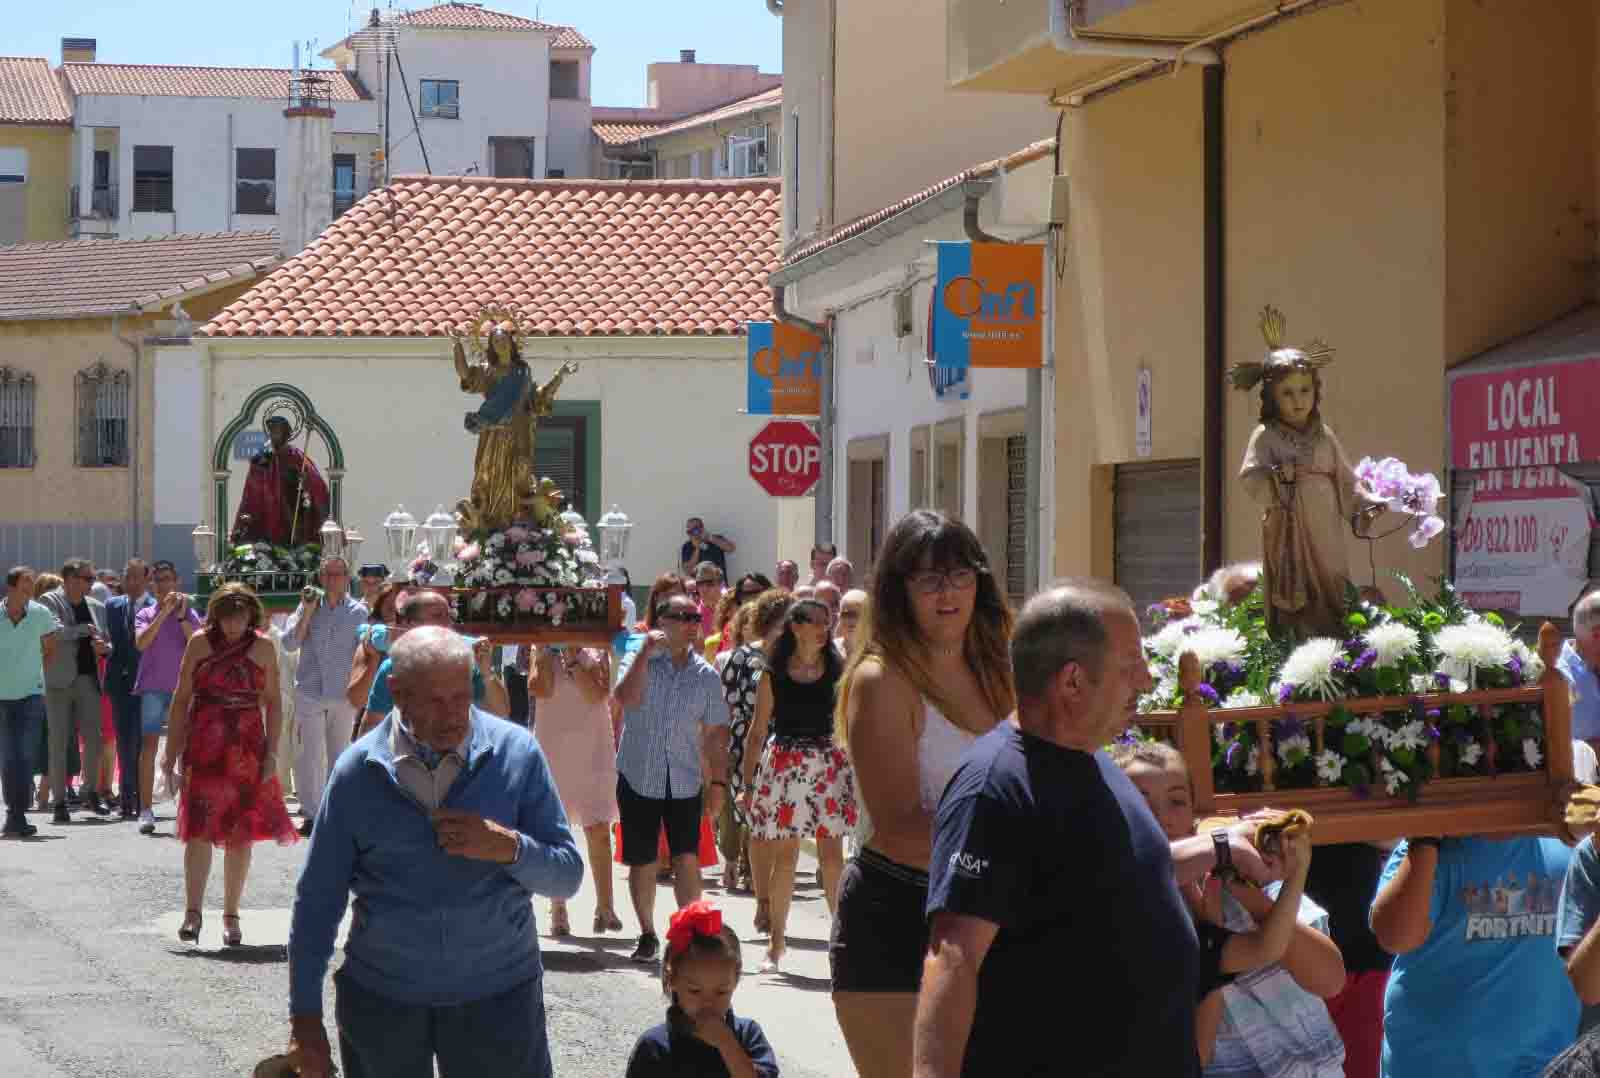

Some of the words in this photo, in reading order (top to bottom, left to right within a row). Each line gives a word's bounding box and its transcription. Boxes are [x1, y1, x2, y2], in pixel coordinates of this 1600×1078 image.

[1487, 376, 1560, 431] LOCAL
[752, 443, 819, 475] STOP
[1513, 514, 1537, 552] 100
[1466, 911, 1554, 940] FORTNIT
